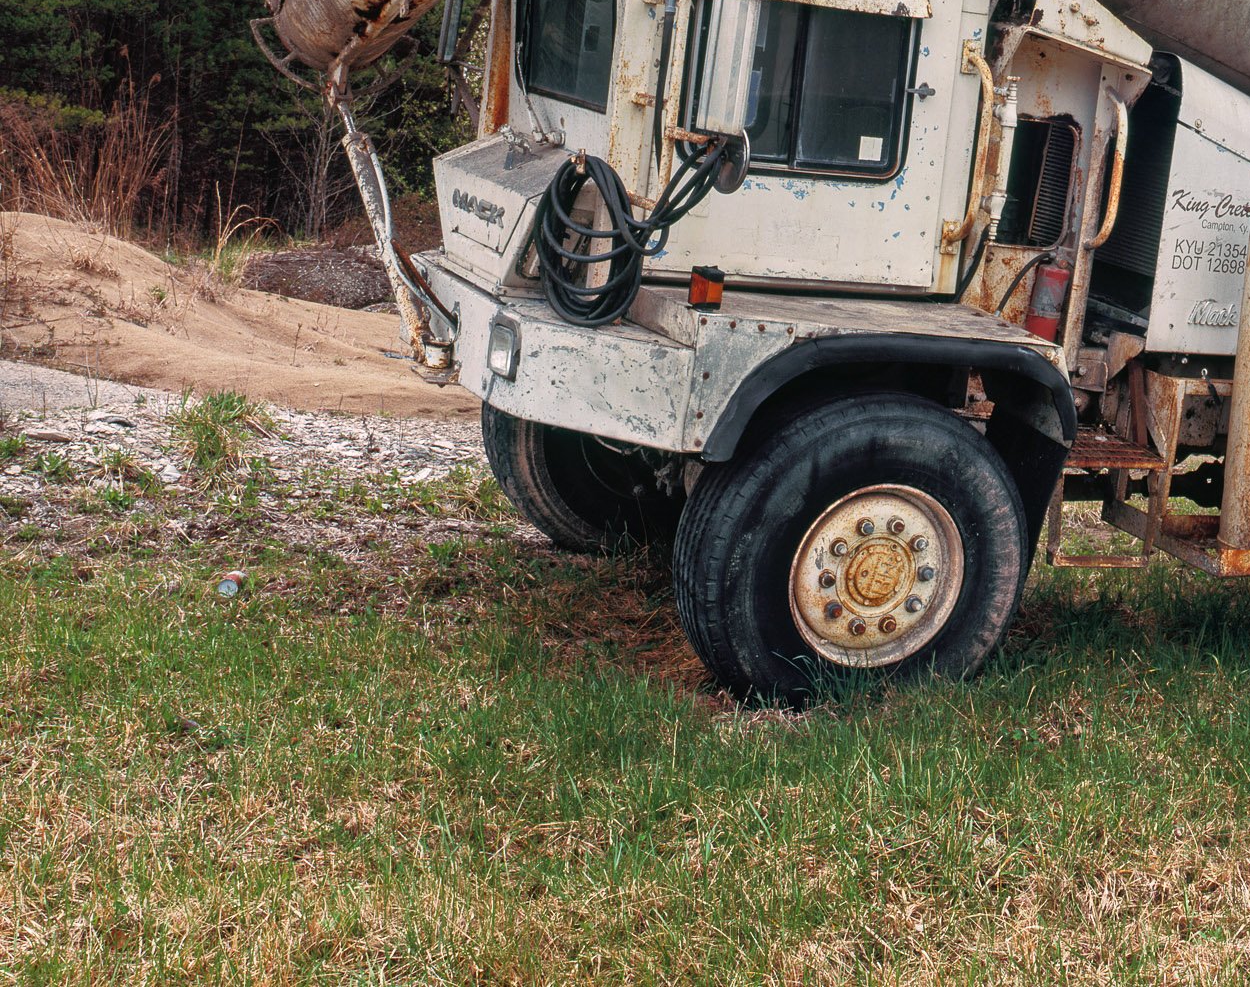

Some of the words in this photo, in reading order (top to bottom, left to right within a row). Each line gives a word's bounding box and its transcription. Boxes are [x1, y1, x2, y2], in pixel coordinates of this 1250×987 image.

[453, 188, 505, 228] MACK
[1201, 219, 1236, 233] Campton,
[1175, 238, 1204, 255] KYU
[1207, 241, 1247, 259] 21354
[1172, 254, 1203, 271] DOT
[1207, 257, 1245, 275] 12698
[1187, 299, 1237, 327] Mack
